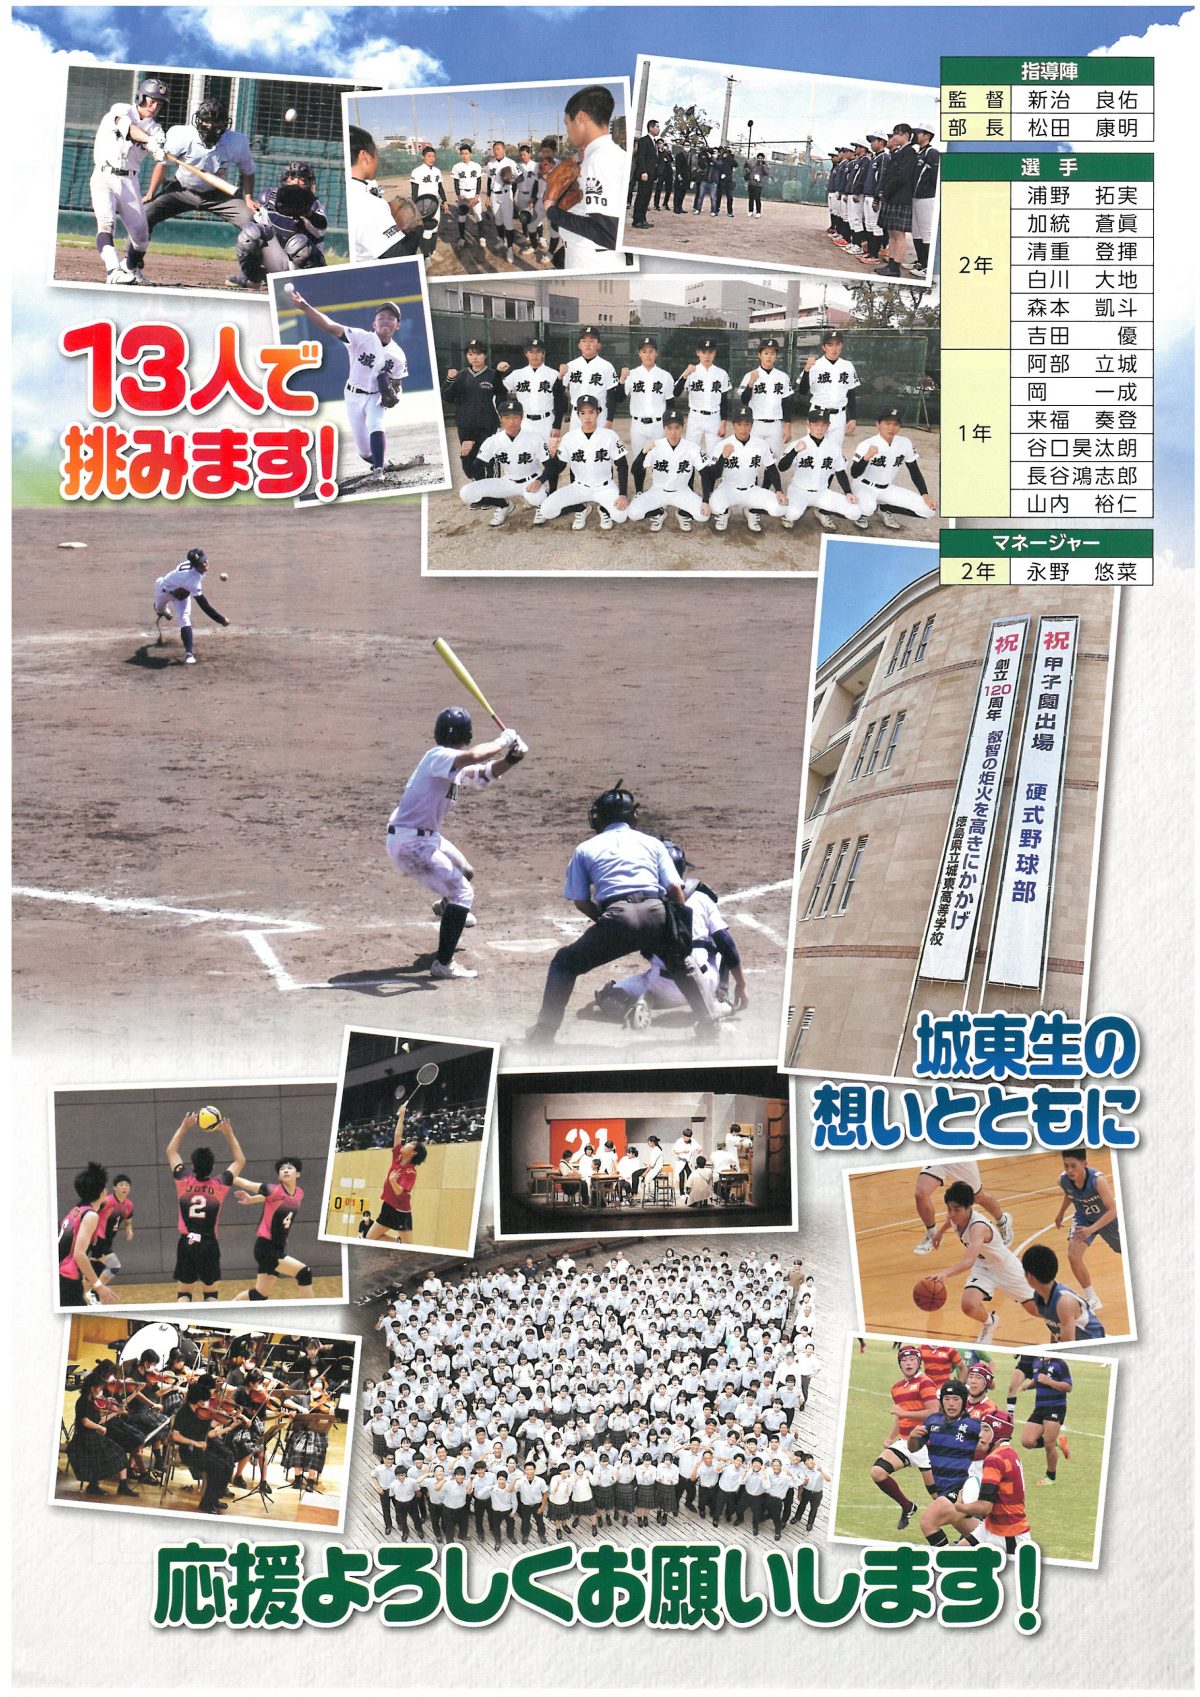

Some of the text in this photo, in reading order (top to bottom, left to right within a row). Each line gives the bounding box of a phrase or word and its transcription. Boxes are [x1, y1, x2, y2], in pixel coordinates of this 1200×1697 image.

[1022, 62, 1078, 80] 指導陣
[1029, 90, 1137, 109] 新治 良佑
[1029, 118, 1137, 137] 松田 康明
[1028, 186, 1137, 205] 浦野 拓実
[1028, 214, 1137, 232] 加統 蒼眞
[1028, 242, 1137, 261] 清重 登揮
[959, 256, 993, 274] 2年
[1029, 270, 1137, 288] 白川 大地
[1028, 298, 1137, 317] 森本 凱斗
[1028, 326, 1136, 345] 吉田 優
[64, 323, 321, 414] 13人で
[1029, 354, 1136, 373] 阿部 立城
[1029, 383, 1137, 401] 岡 一成
[1028, 411, 1136, 429] 来福 奏登
[960, 424, 991, 442] 1年
[1028, 439, 1136, 457] 谷口昊汰朗
[65, 426, 337, 498] 挑みます!
[1028, 466, 1136, 485] 長谷鴻志郎
[1028, 495, 1136, 513] 山内 裕仁
[993, 534, 1099, 551] マネージャー
[962, 562, 995, 581] 2年
[1027, 562, 1136, 581] 永野 悠菜
[994, 634, 1019, 654] 祝
[1043, 631, 1070, 650] 祝
[1011, 657, 1064, 904] 甲子園出場 硬式野球部
[929, 815, 968, 946] 徳島県立城東高等学校
[916, 1013, 1136, 1076] 城東生の
[814, 1084, 1136, 1147] 想いとともに
[189, 1195, 207, 1218] 2
[282, 1211, 293, 1229] 4
